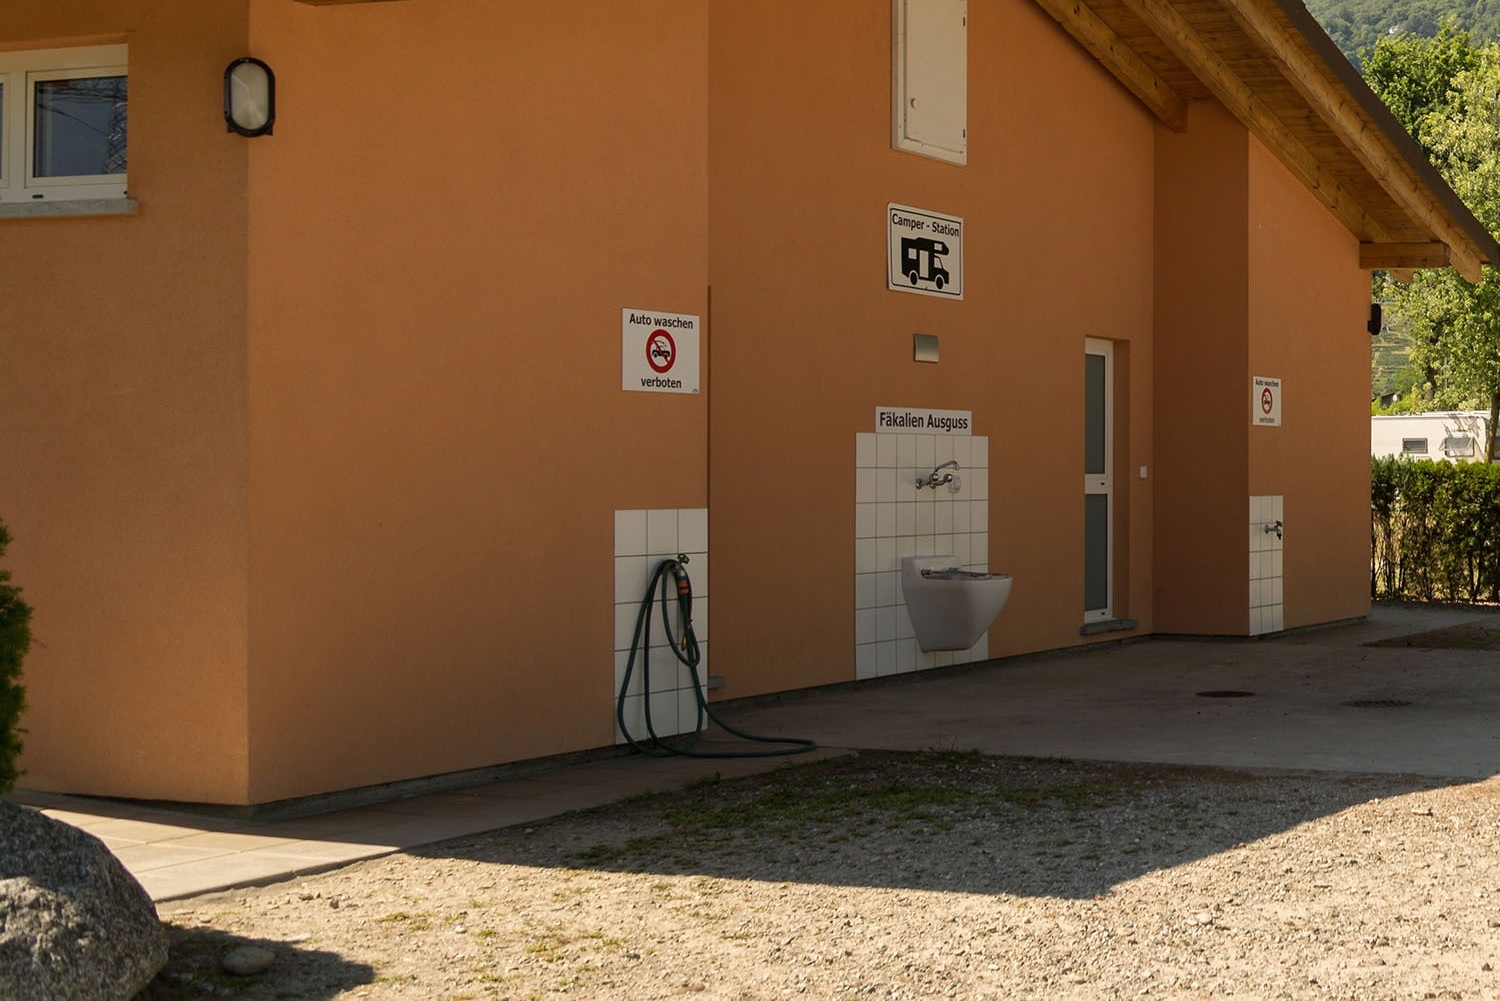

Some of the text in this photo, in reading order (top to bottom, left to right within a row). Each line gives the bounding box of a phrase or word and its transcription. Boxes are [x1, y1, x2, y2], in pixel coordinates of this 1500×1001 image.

[892, 213, 925, 230] Camper
[931, 221, 960, 237] Station
[629, 313, 694, 329] Auto waschen
[641, 377, 682, 388] verboten
[880, 412, 968, 432] Fäkalien Ausguss
